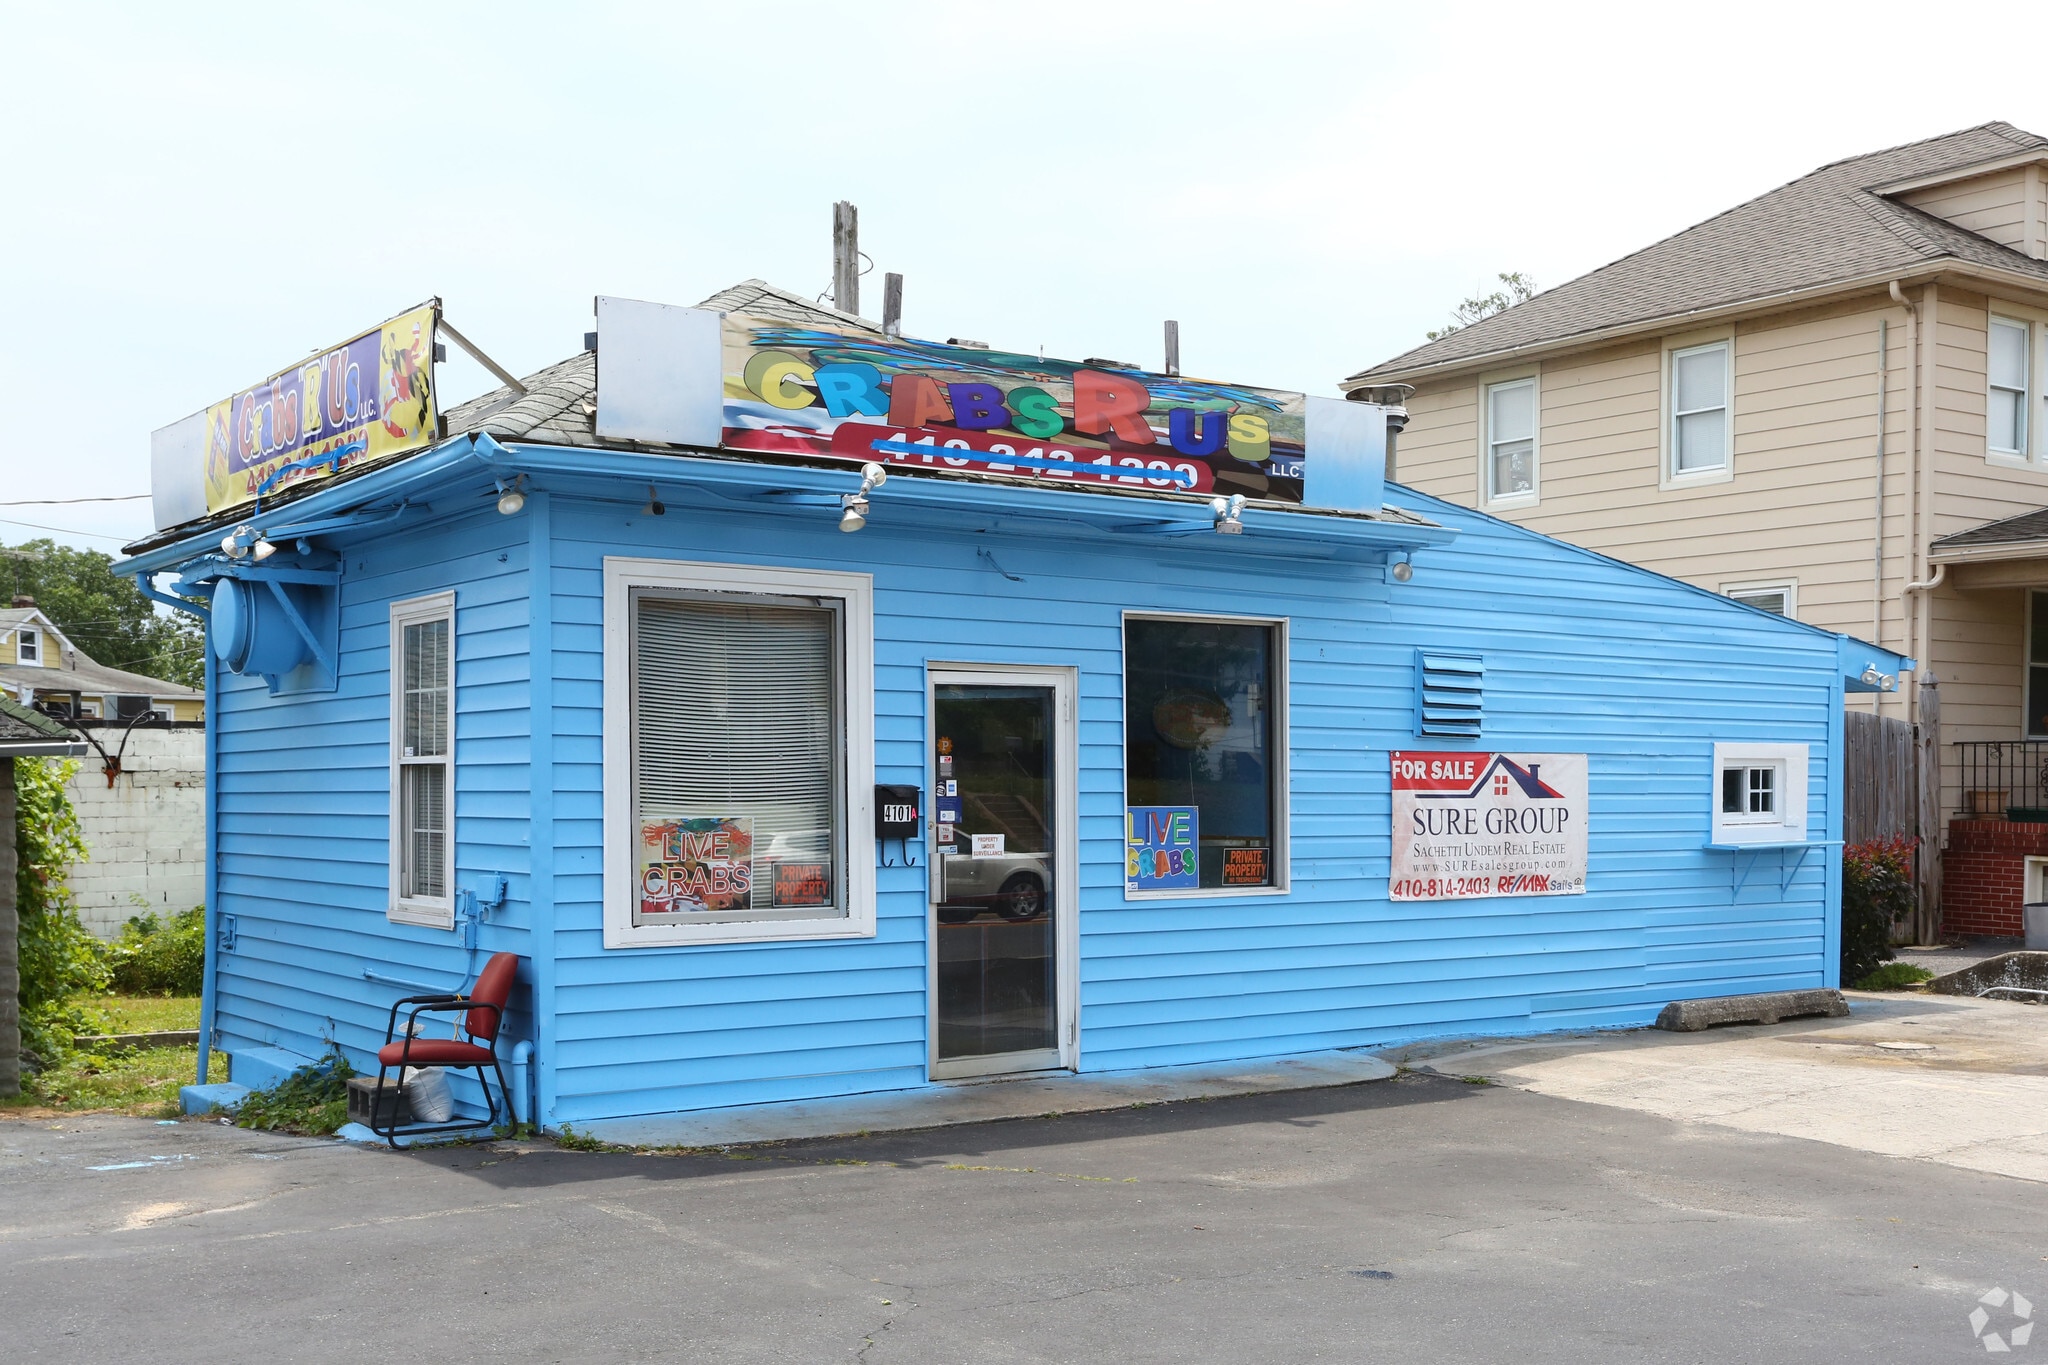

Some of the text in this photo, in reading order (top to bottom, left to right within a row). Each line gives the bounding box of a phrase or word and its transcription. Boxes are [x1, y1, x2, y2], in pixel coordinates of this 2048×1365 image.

[239, 376, 297, 463] Crabs
[328, 346, 361, 428] Us
[744, 350, 1271, 461] CRABS R US
[1271, 463, 1299, 478] LLC
[1392, 759, 1475, 780] FOR SALE
[1128, 812, 1191, 845] LIVE
[1413, 807, 1569, 836] SURE GROUP
[661, 832, 730, 862] LIVE
[1230, 850, 1263, 863] PRIVATE
[781, 865, 823, 880] PRIVATE
[1128, 847, 1197, 879] CRABS
[1224, 863, 1267, 877] PROPERTY
[1413, 859, 1567, 874] www.SUREsalesgroup.com
[642, 865, 751, 896] CRABS
[775, 881, 829, 897] PROPERTY
[1393, 877, 1490, 898] 410-814-2403
